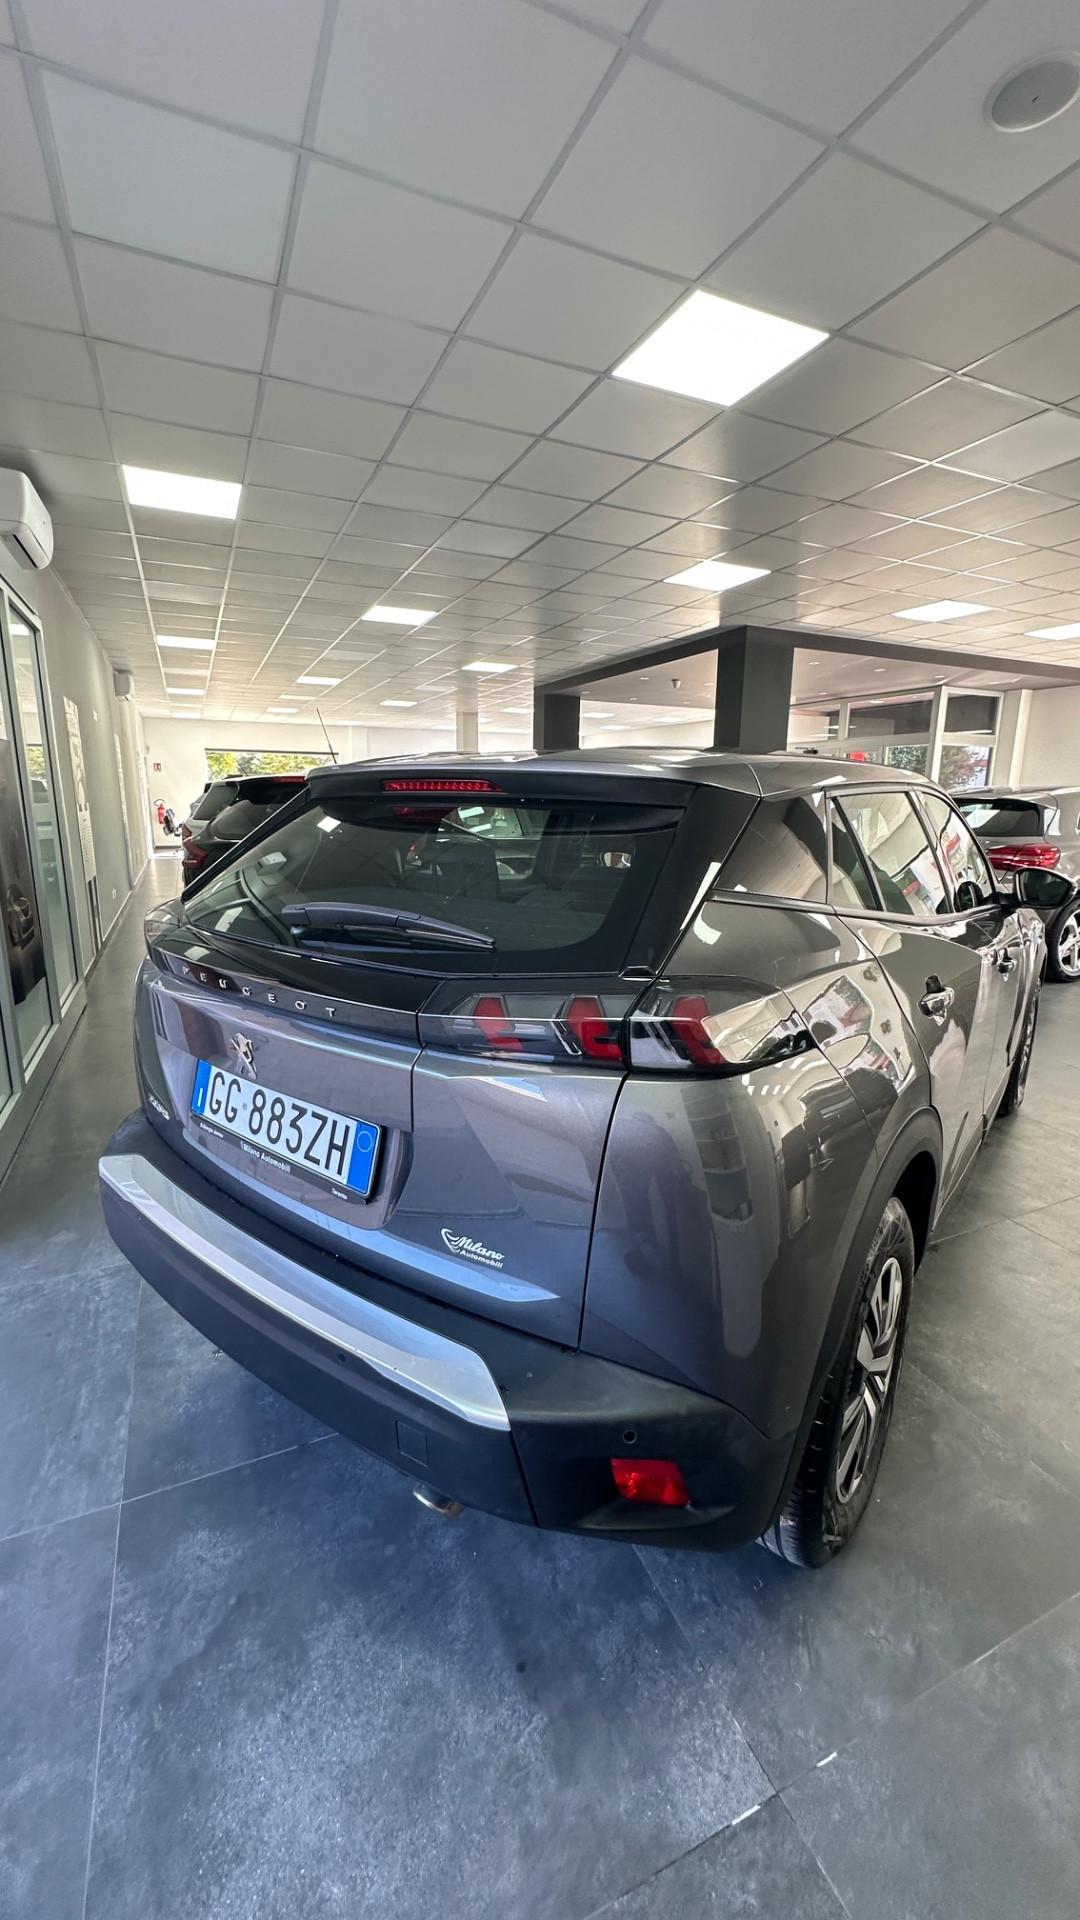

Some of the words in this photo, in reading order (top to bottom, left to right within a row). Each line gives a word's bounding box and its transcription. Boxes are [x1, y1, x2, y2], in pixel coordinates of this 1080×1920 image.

[182, 966, 335, 1018] PEUGEOT
[209, 1071, 242, 1124] GG
[248, 1088, 351, 1176] 883ZH
[459, 1236, 505, 1260] Milano
[460, 1249, 504, 1269] Automobili
